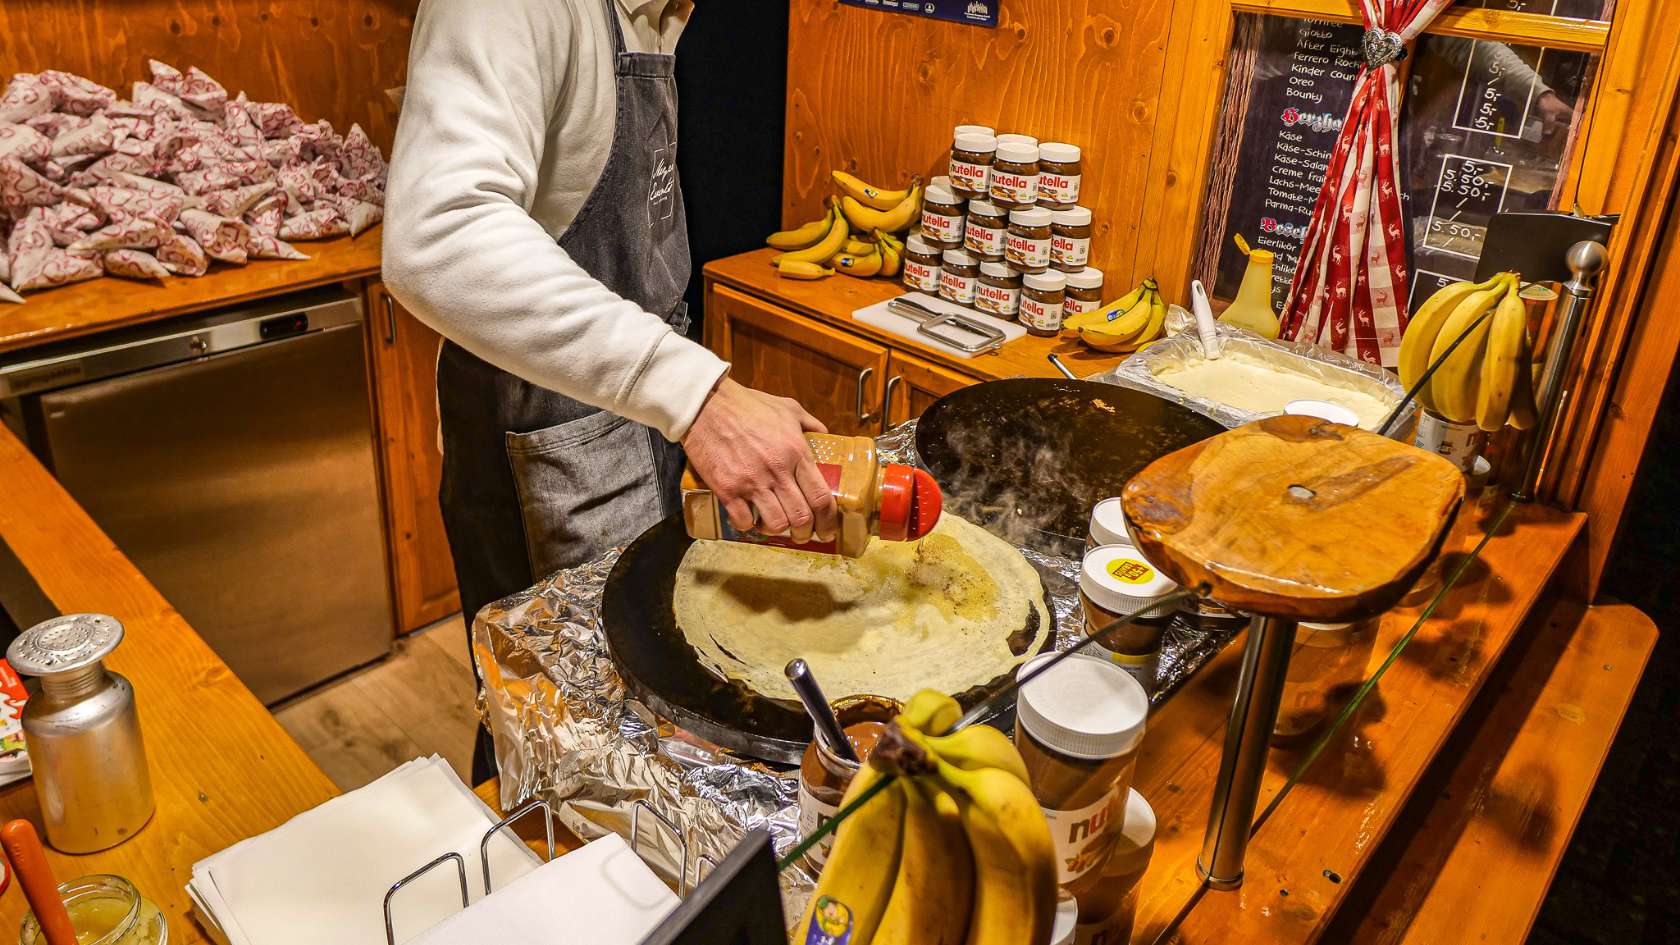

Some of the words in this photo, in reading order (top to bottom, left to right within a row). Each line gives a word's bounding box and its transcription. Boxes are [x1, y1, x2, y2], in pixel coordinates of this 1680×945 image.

[1297, 39, 1325, 50] After
[1294, 51, 1329, 64] Ferrero
[1291, 63, 1325, 76] Kinder
[1289, 76, 1314, 86] Oreo
[1286, 87, 1323, 104] Bounty
[1279, 130, 1303, 142] Käse
[1272, 165, 1304, 178] Creme
[1257, 236, 1297, 252] Eierlikör
[976, 285, 1009, 301] nutella
